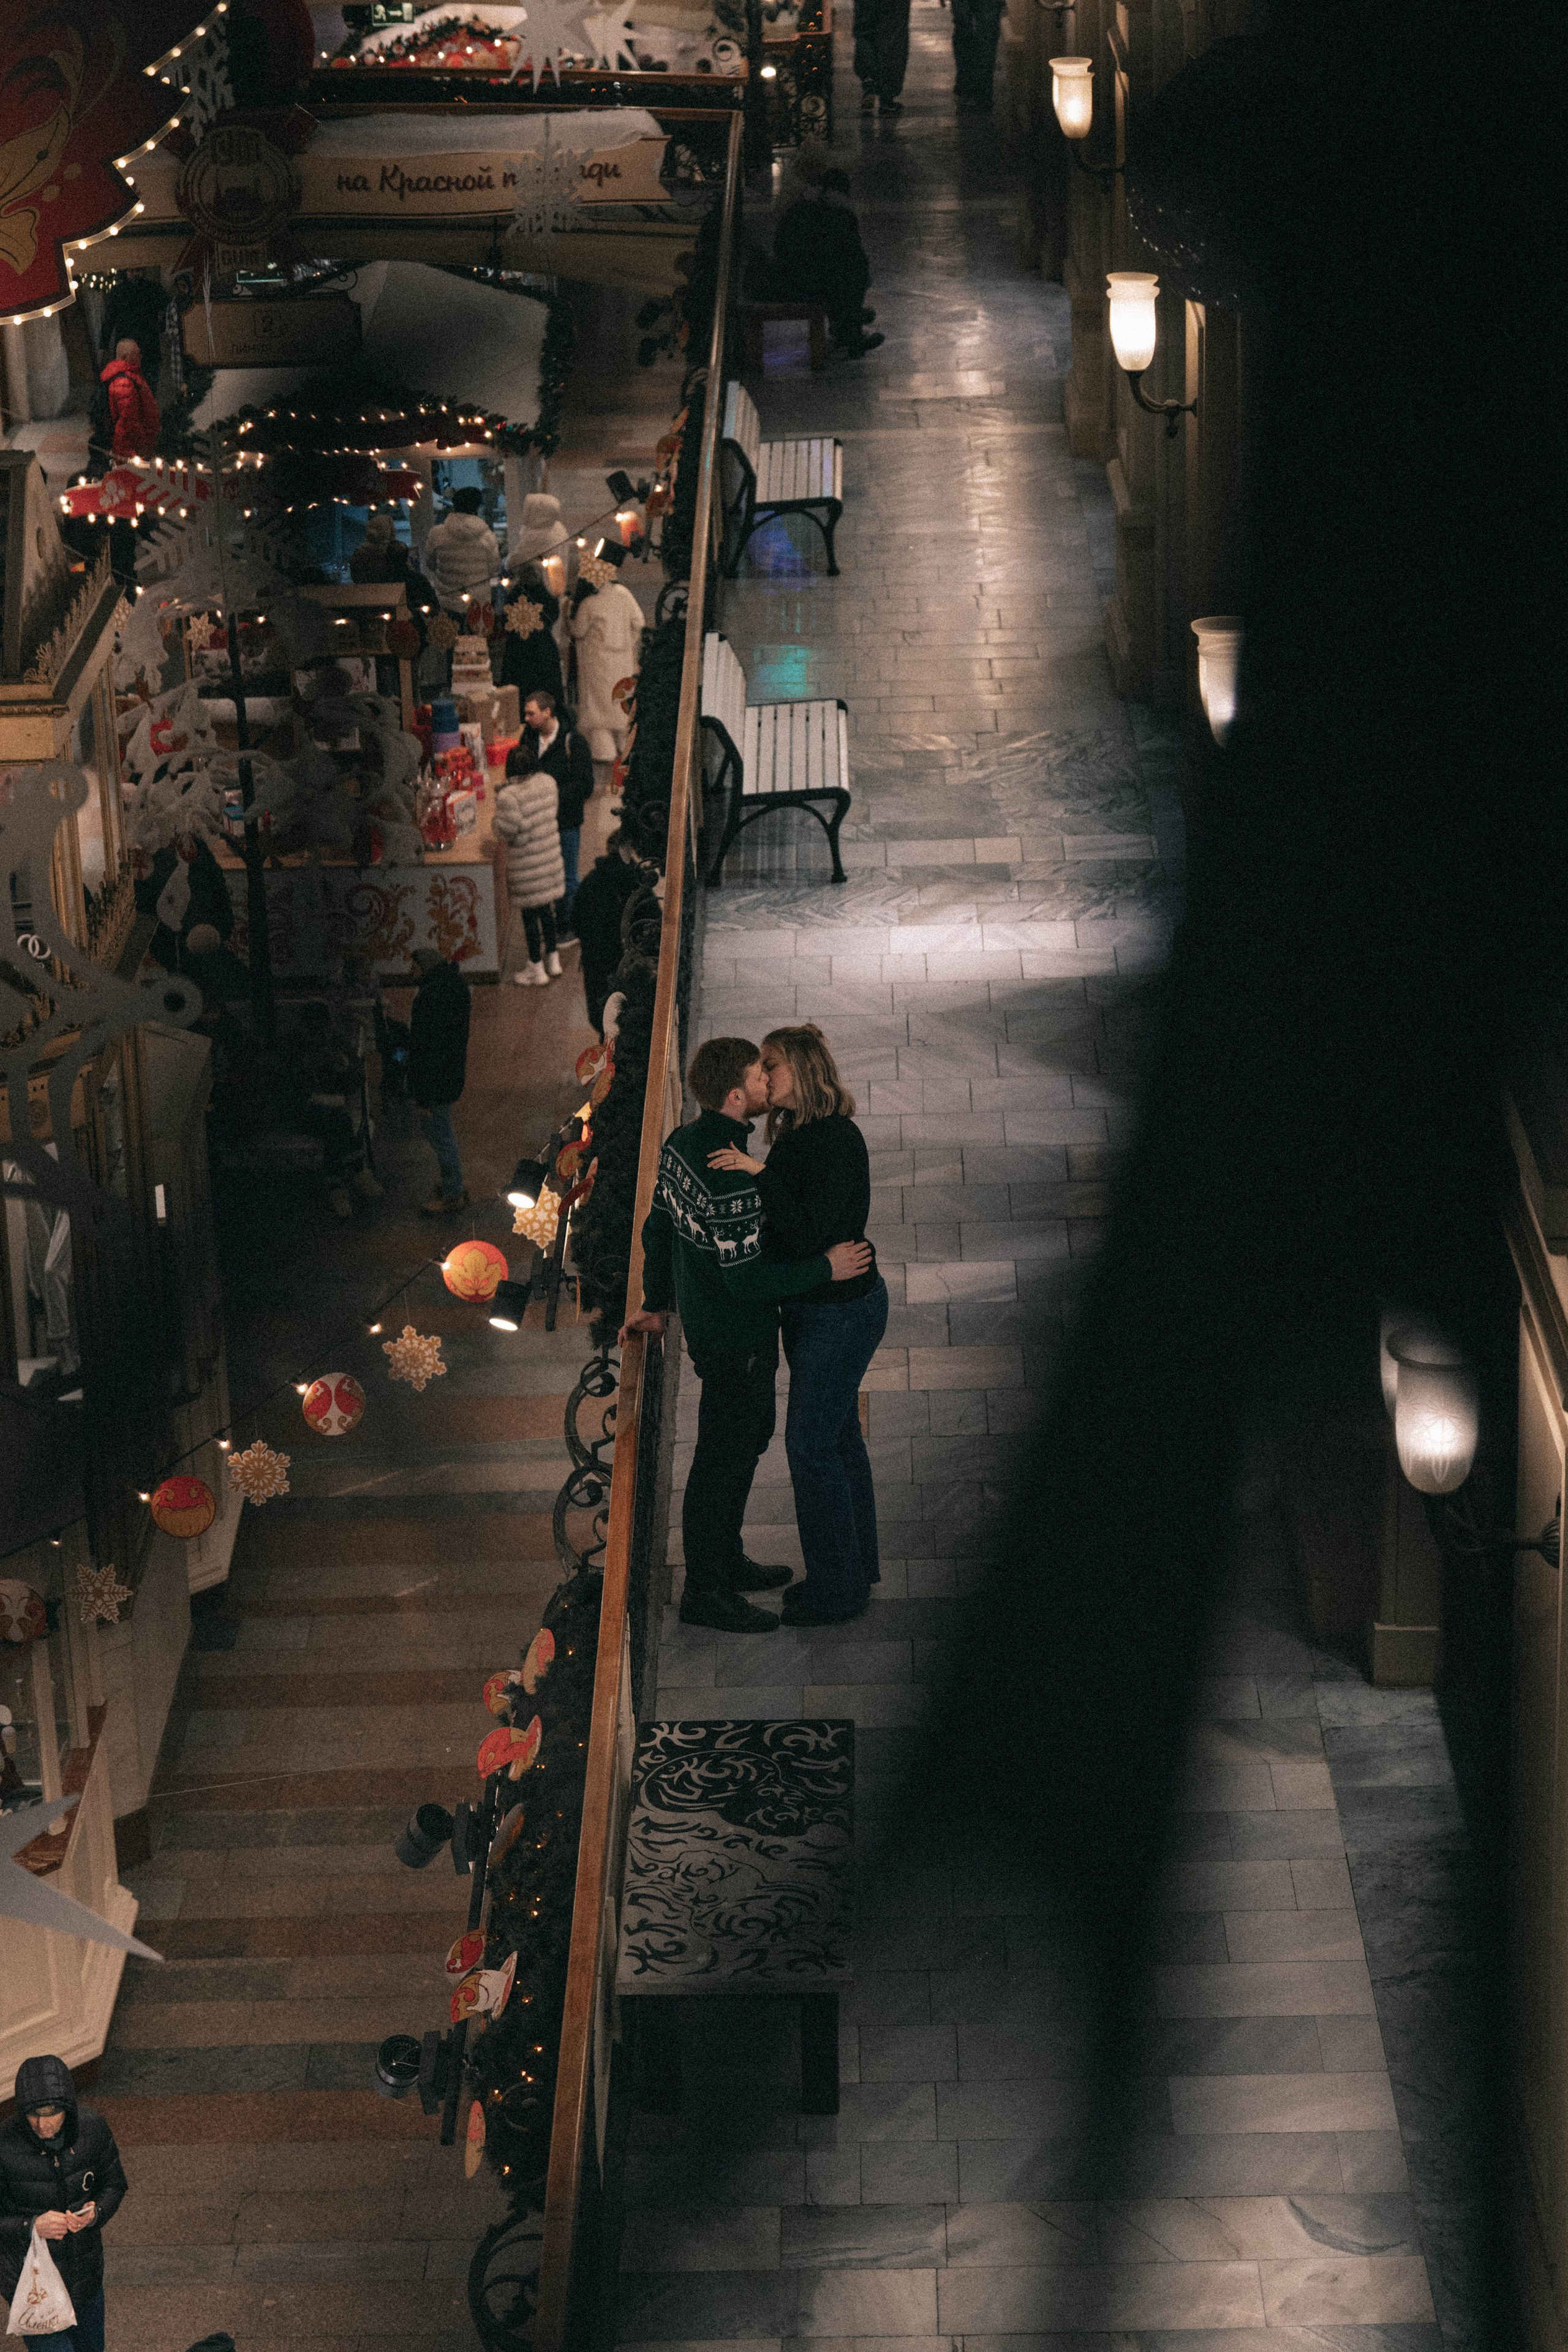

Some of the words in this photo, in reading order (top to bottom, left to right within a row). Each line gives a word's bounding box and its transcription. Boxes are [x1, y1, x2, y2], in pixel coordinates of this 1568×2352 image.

[336, 173, 369, 191] на
[379, 164, 495, 202] Красной
[262, 315, 274, 333] 2
